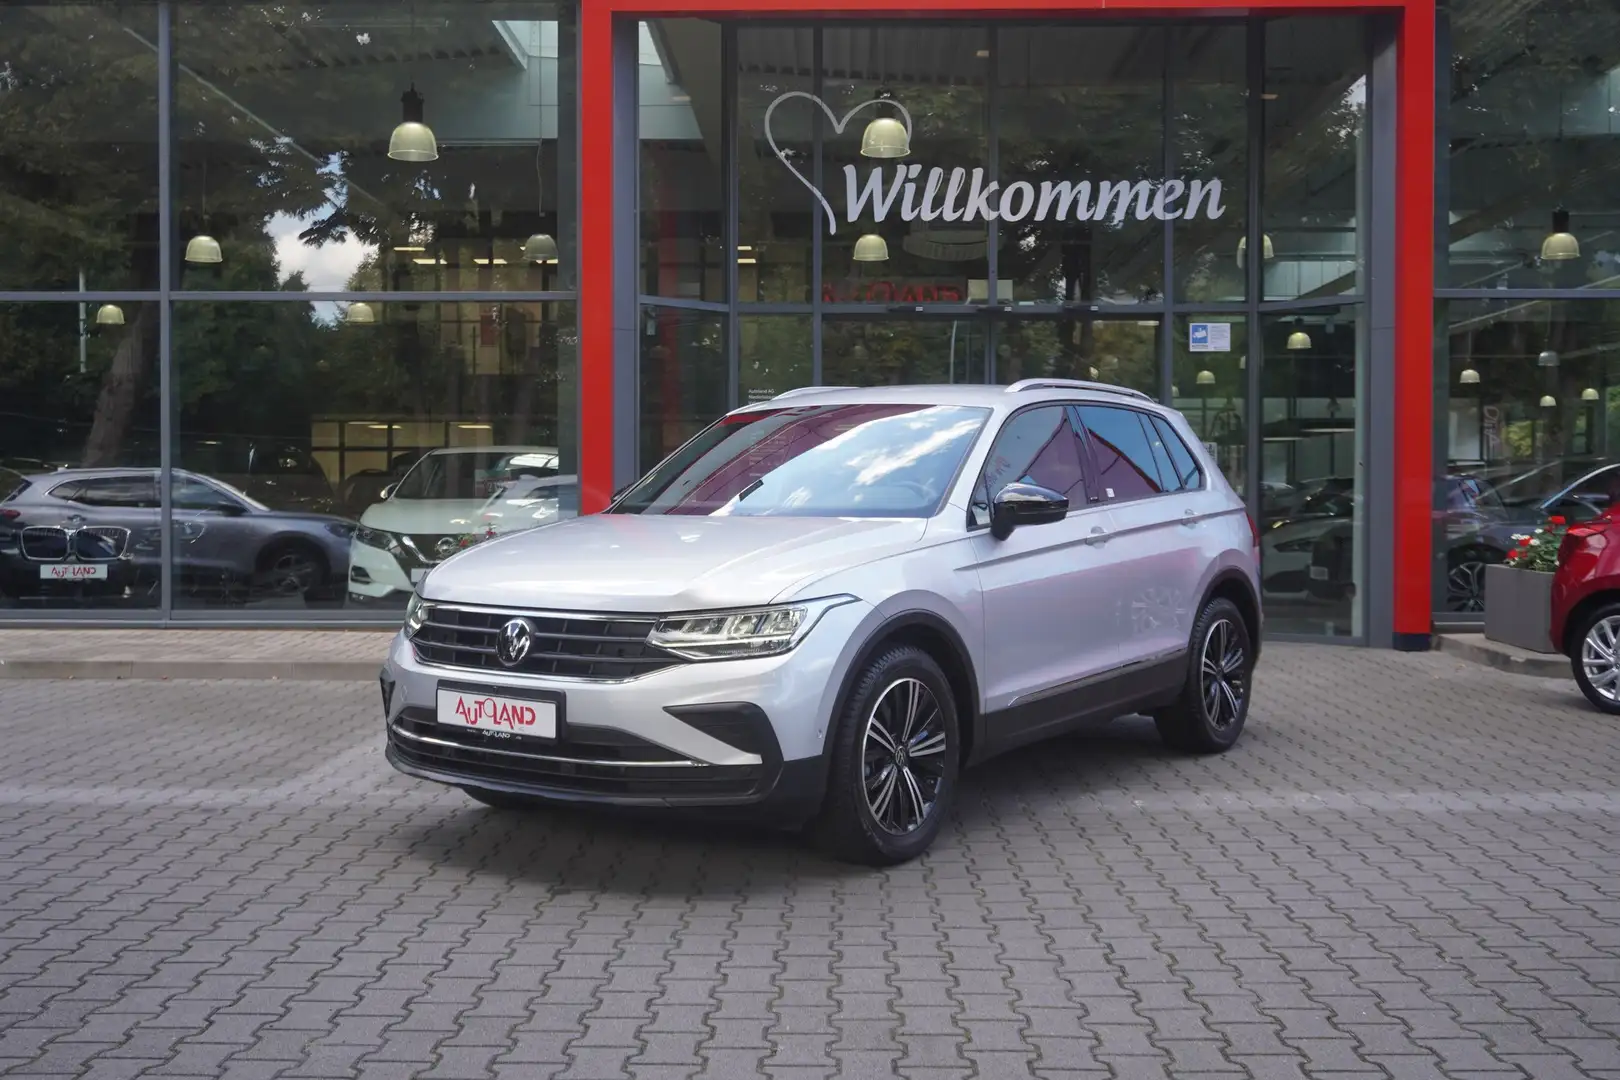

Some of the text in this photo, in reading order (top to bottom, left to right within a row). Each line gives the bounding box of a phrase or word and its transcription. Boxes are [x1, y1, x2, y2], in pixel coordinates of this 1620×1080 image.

[843, 163, 1226, 223] Willkommen
[51, 566, 97, 578] AUTLAND
[455, 696, 536, 730] AUTOLAND
